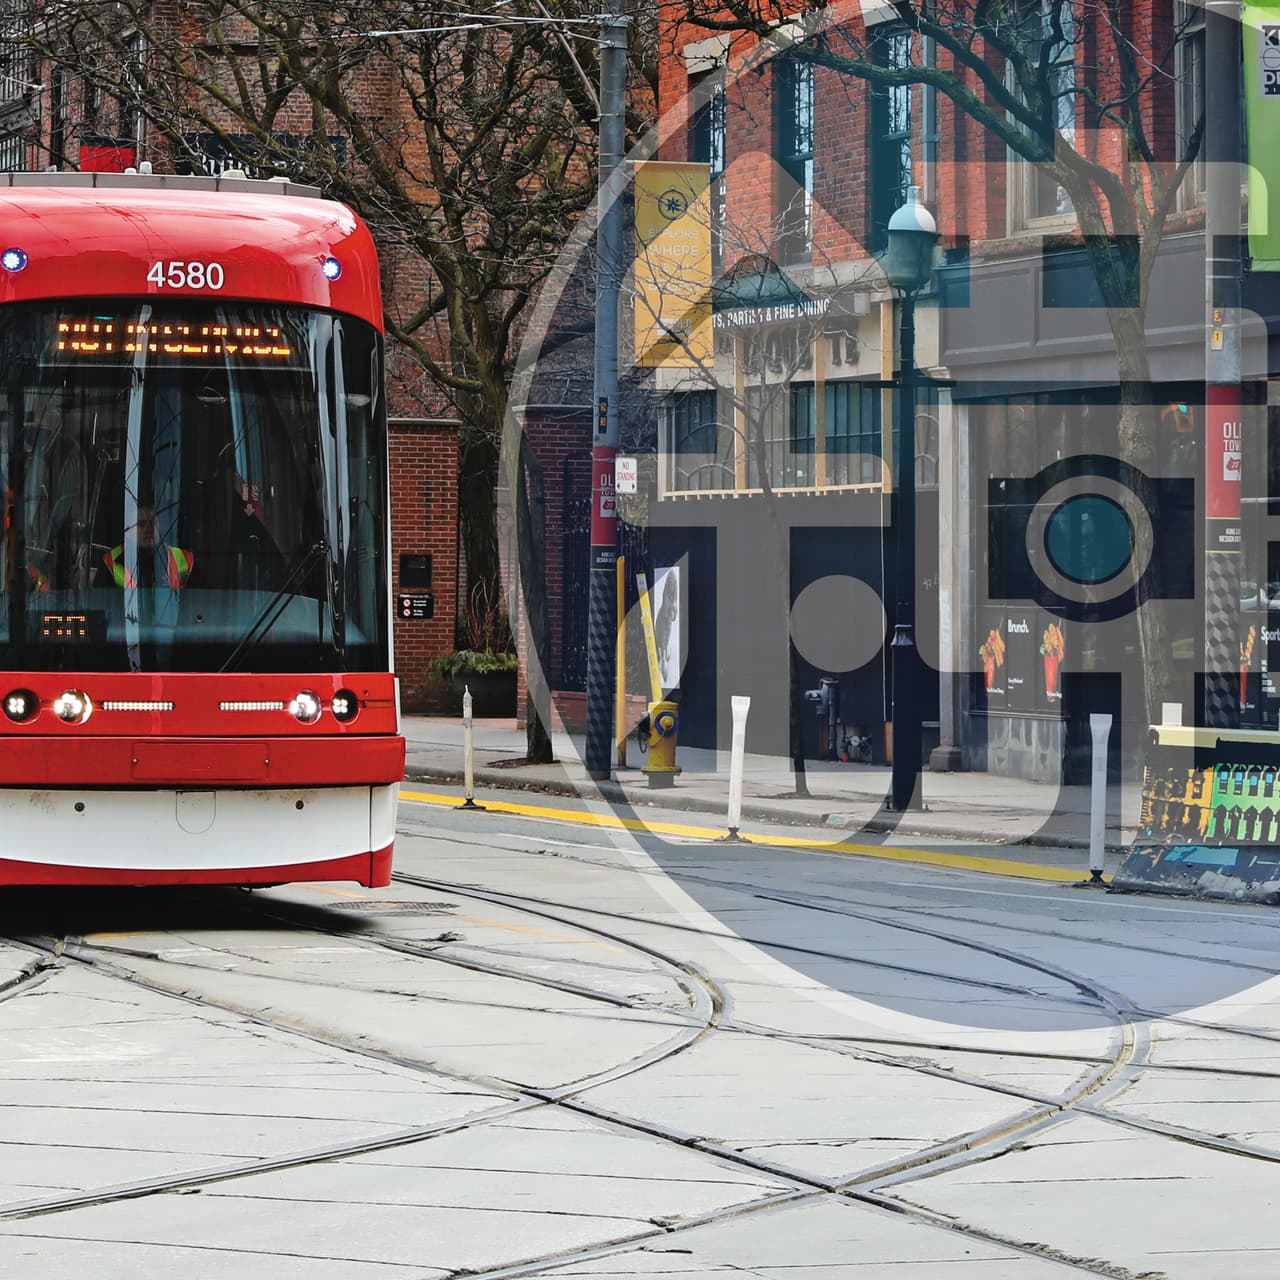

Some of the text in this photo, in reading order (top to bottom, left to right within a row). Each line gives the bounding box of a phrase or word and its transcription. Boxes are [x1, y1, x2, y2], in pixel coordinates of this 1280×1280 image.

[147, 261, 224, 290] 4580
[774, 303, 795, 321] FINE
[1007, 619, 1029, 633] Brunch.
